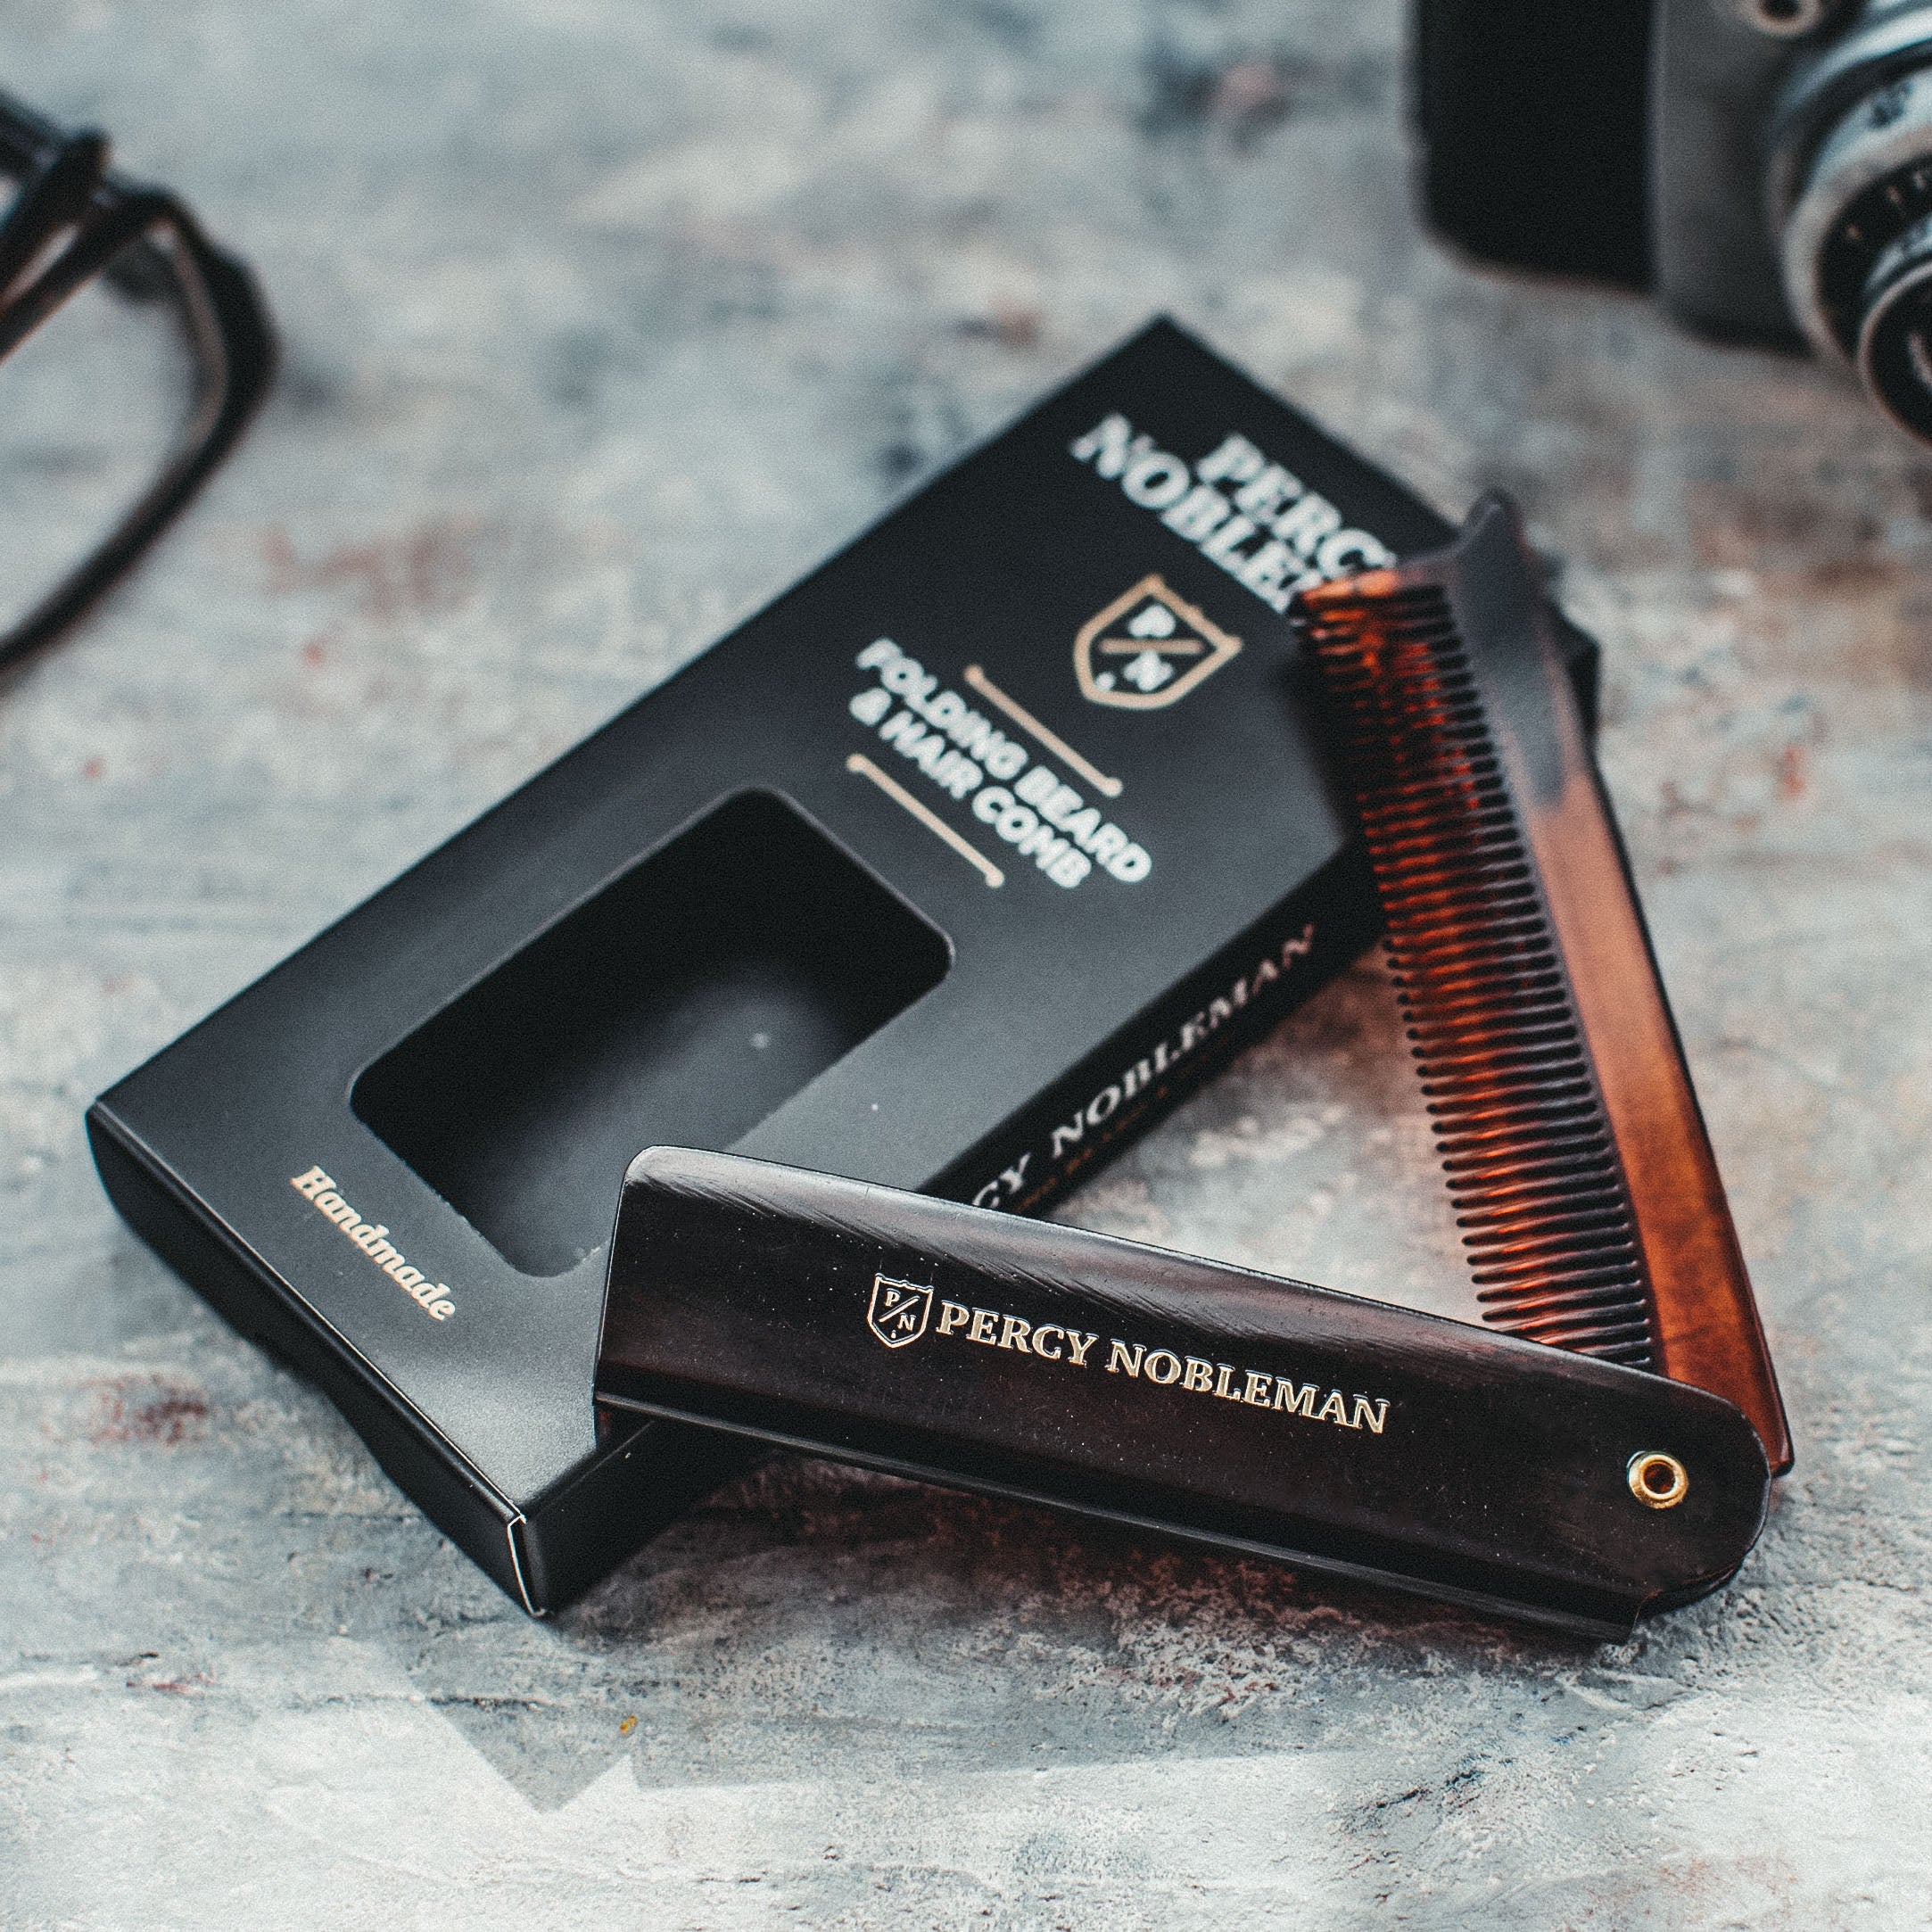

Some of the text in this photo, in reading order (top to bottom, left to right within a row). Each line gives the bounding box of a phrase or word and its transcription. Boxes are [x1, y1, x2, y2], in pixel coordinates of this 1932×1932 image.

[1073, 413, 1324, 615] NOBLE
[1197, 433, 1398, 583] PERC
[855, 637, 1152, 883] FOLDING BEARD
[879, 710, 984, 800] HAIR
[971, 786, 1092, 888] COMB
[971, 1152, 1032, 1210] CY
[1051, 921, 1316, 1158] NOBLEMAN
[289, 1164, 456, 1321] Handmade
[936, 1300, 1391, 1434] PERCY NOBLEMAN
